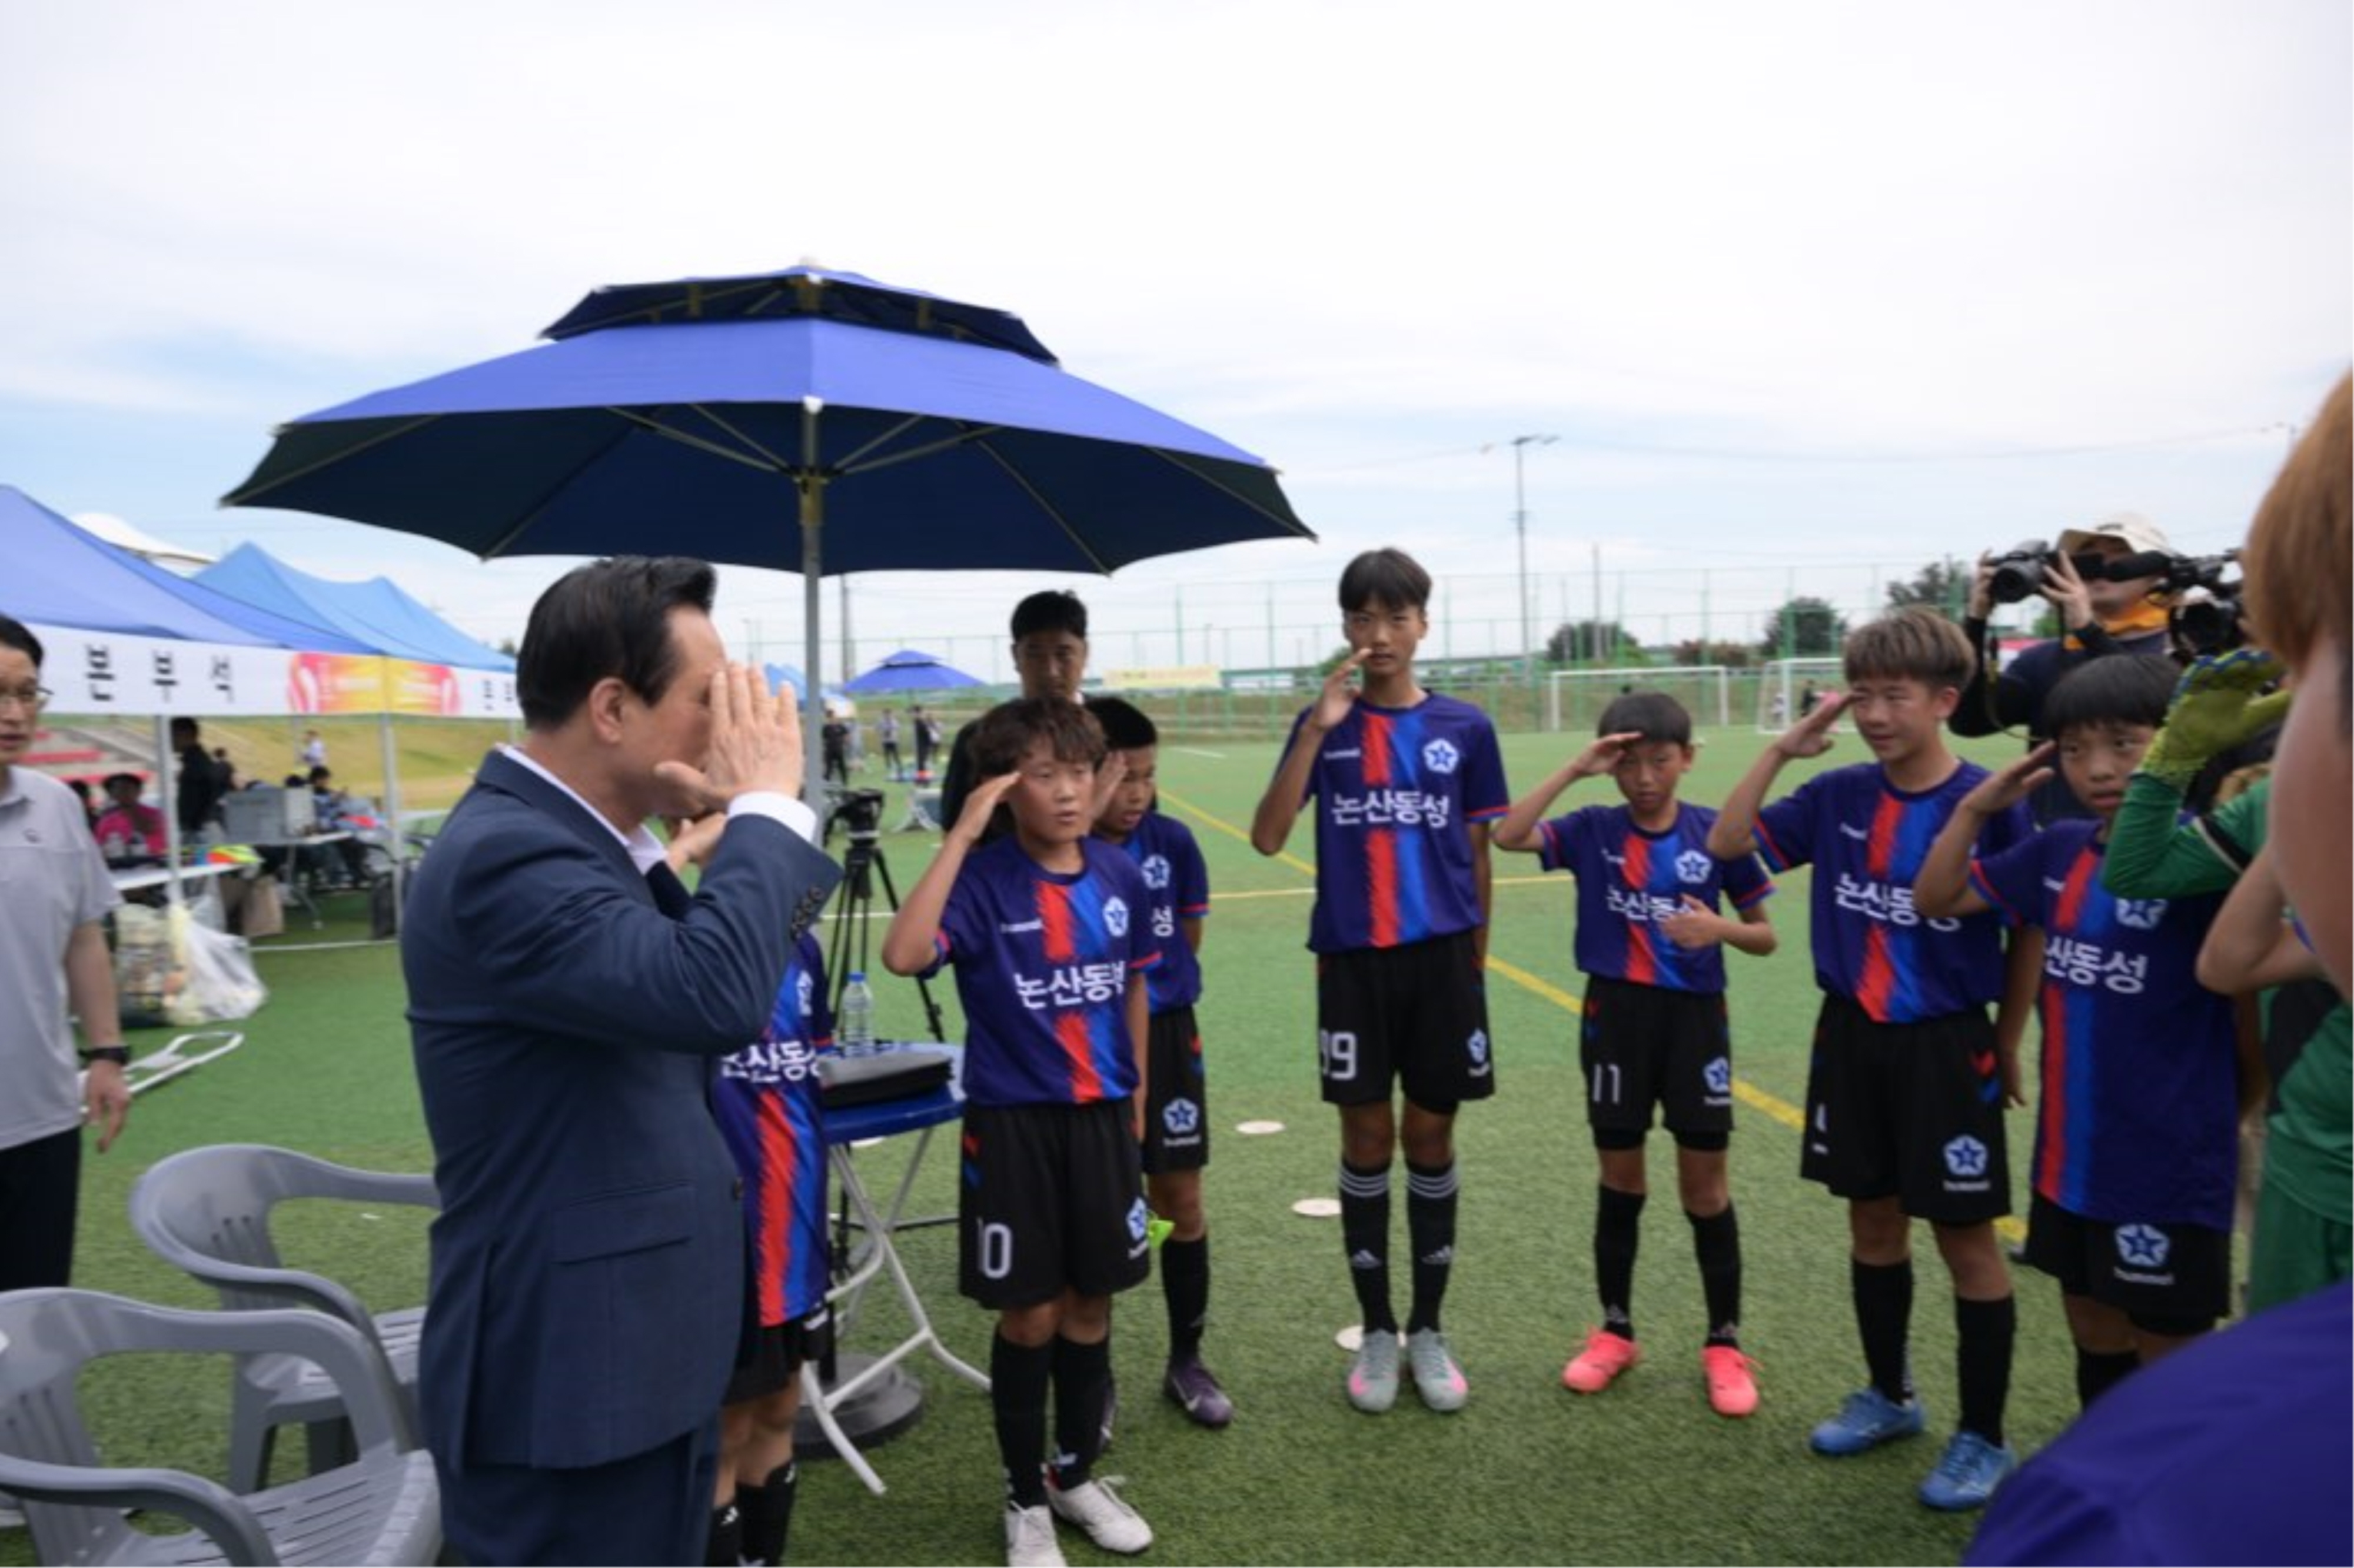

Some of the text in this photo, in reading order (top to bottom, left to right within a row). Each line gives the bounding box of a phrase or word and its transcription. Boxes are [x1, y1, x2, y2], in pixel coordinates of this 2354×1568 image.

[1332, 790, 1449, 828] 논산동성
[2045, 936, 2148, 994] 산동성
[1592, 1064, 1621, 1104] 11
